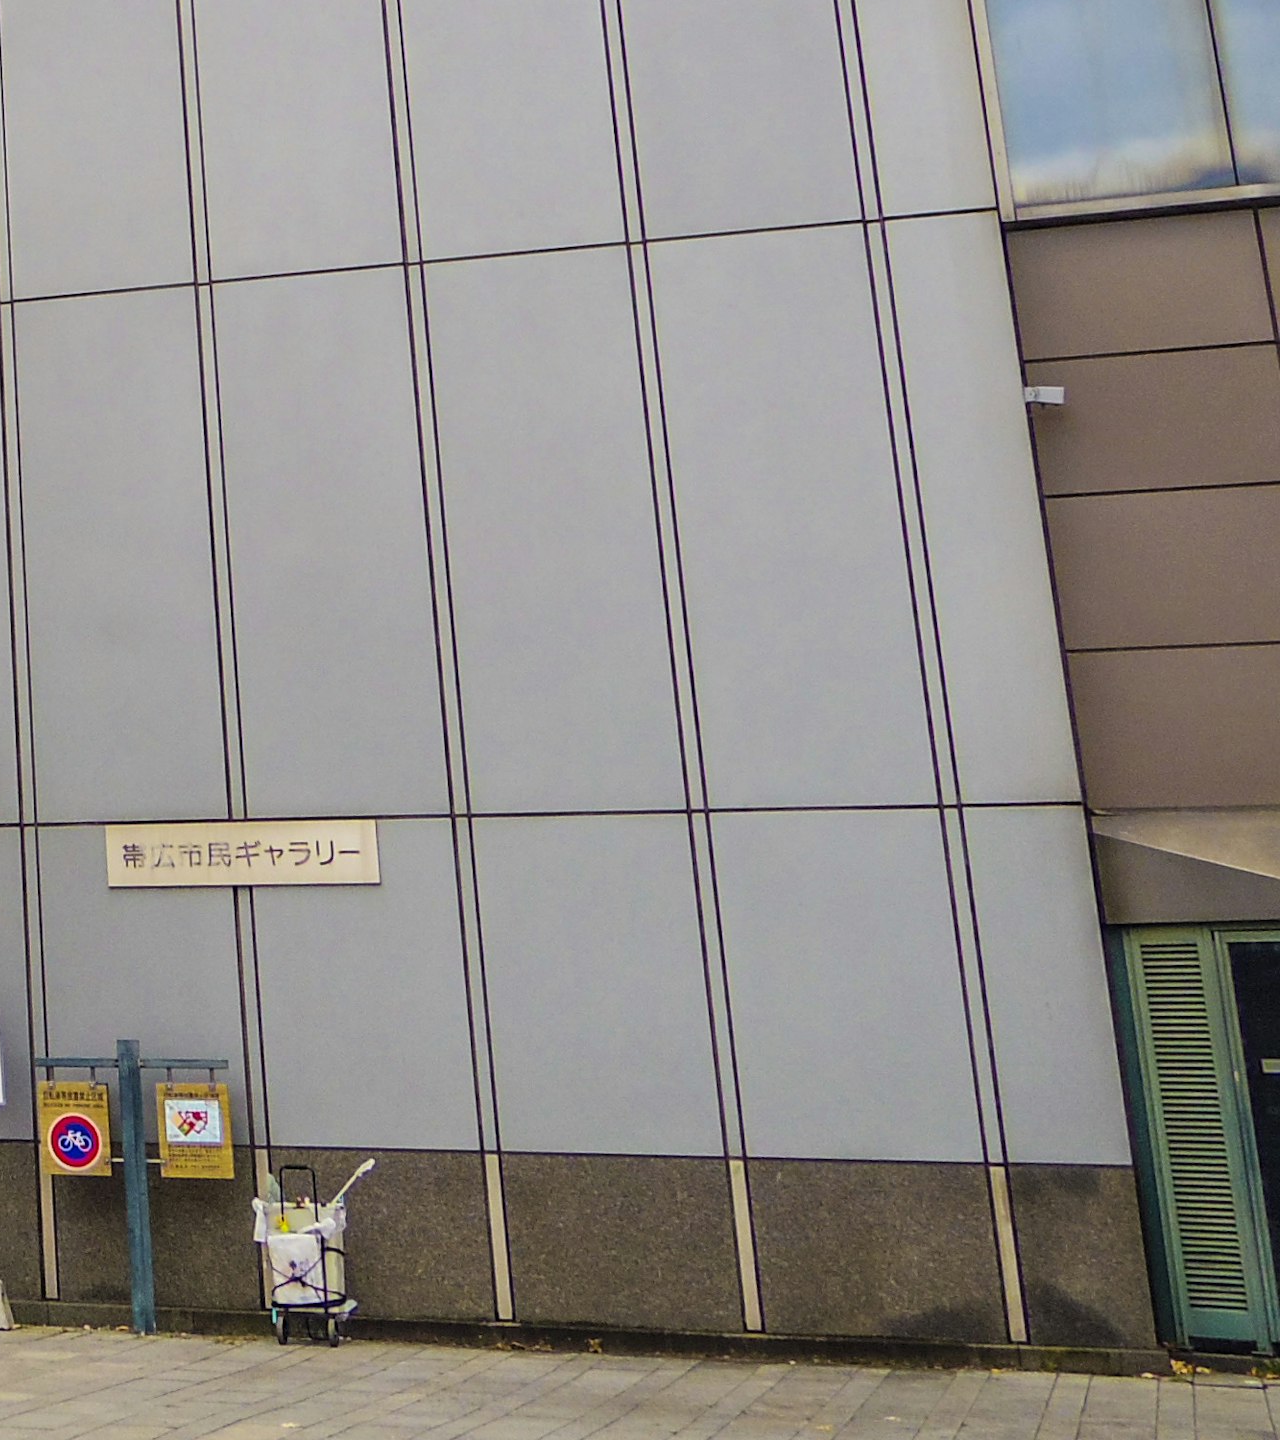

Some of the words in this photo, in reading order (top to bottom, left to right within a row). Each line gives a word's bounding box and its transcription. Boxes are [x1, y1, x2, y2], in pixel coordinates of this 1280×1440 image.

[122, 840, 361, 868] 帯広市民ギャラリー
